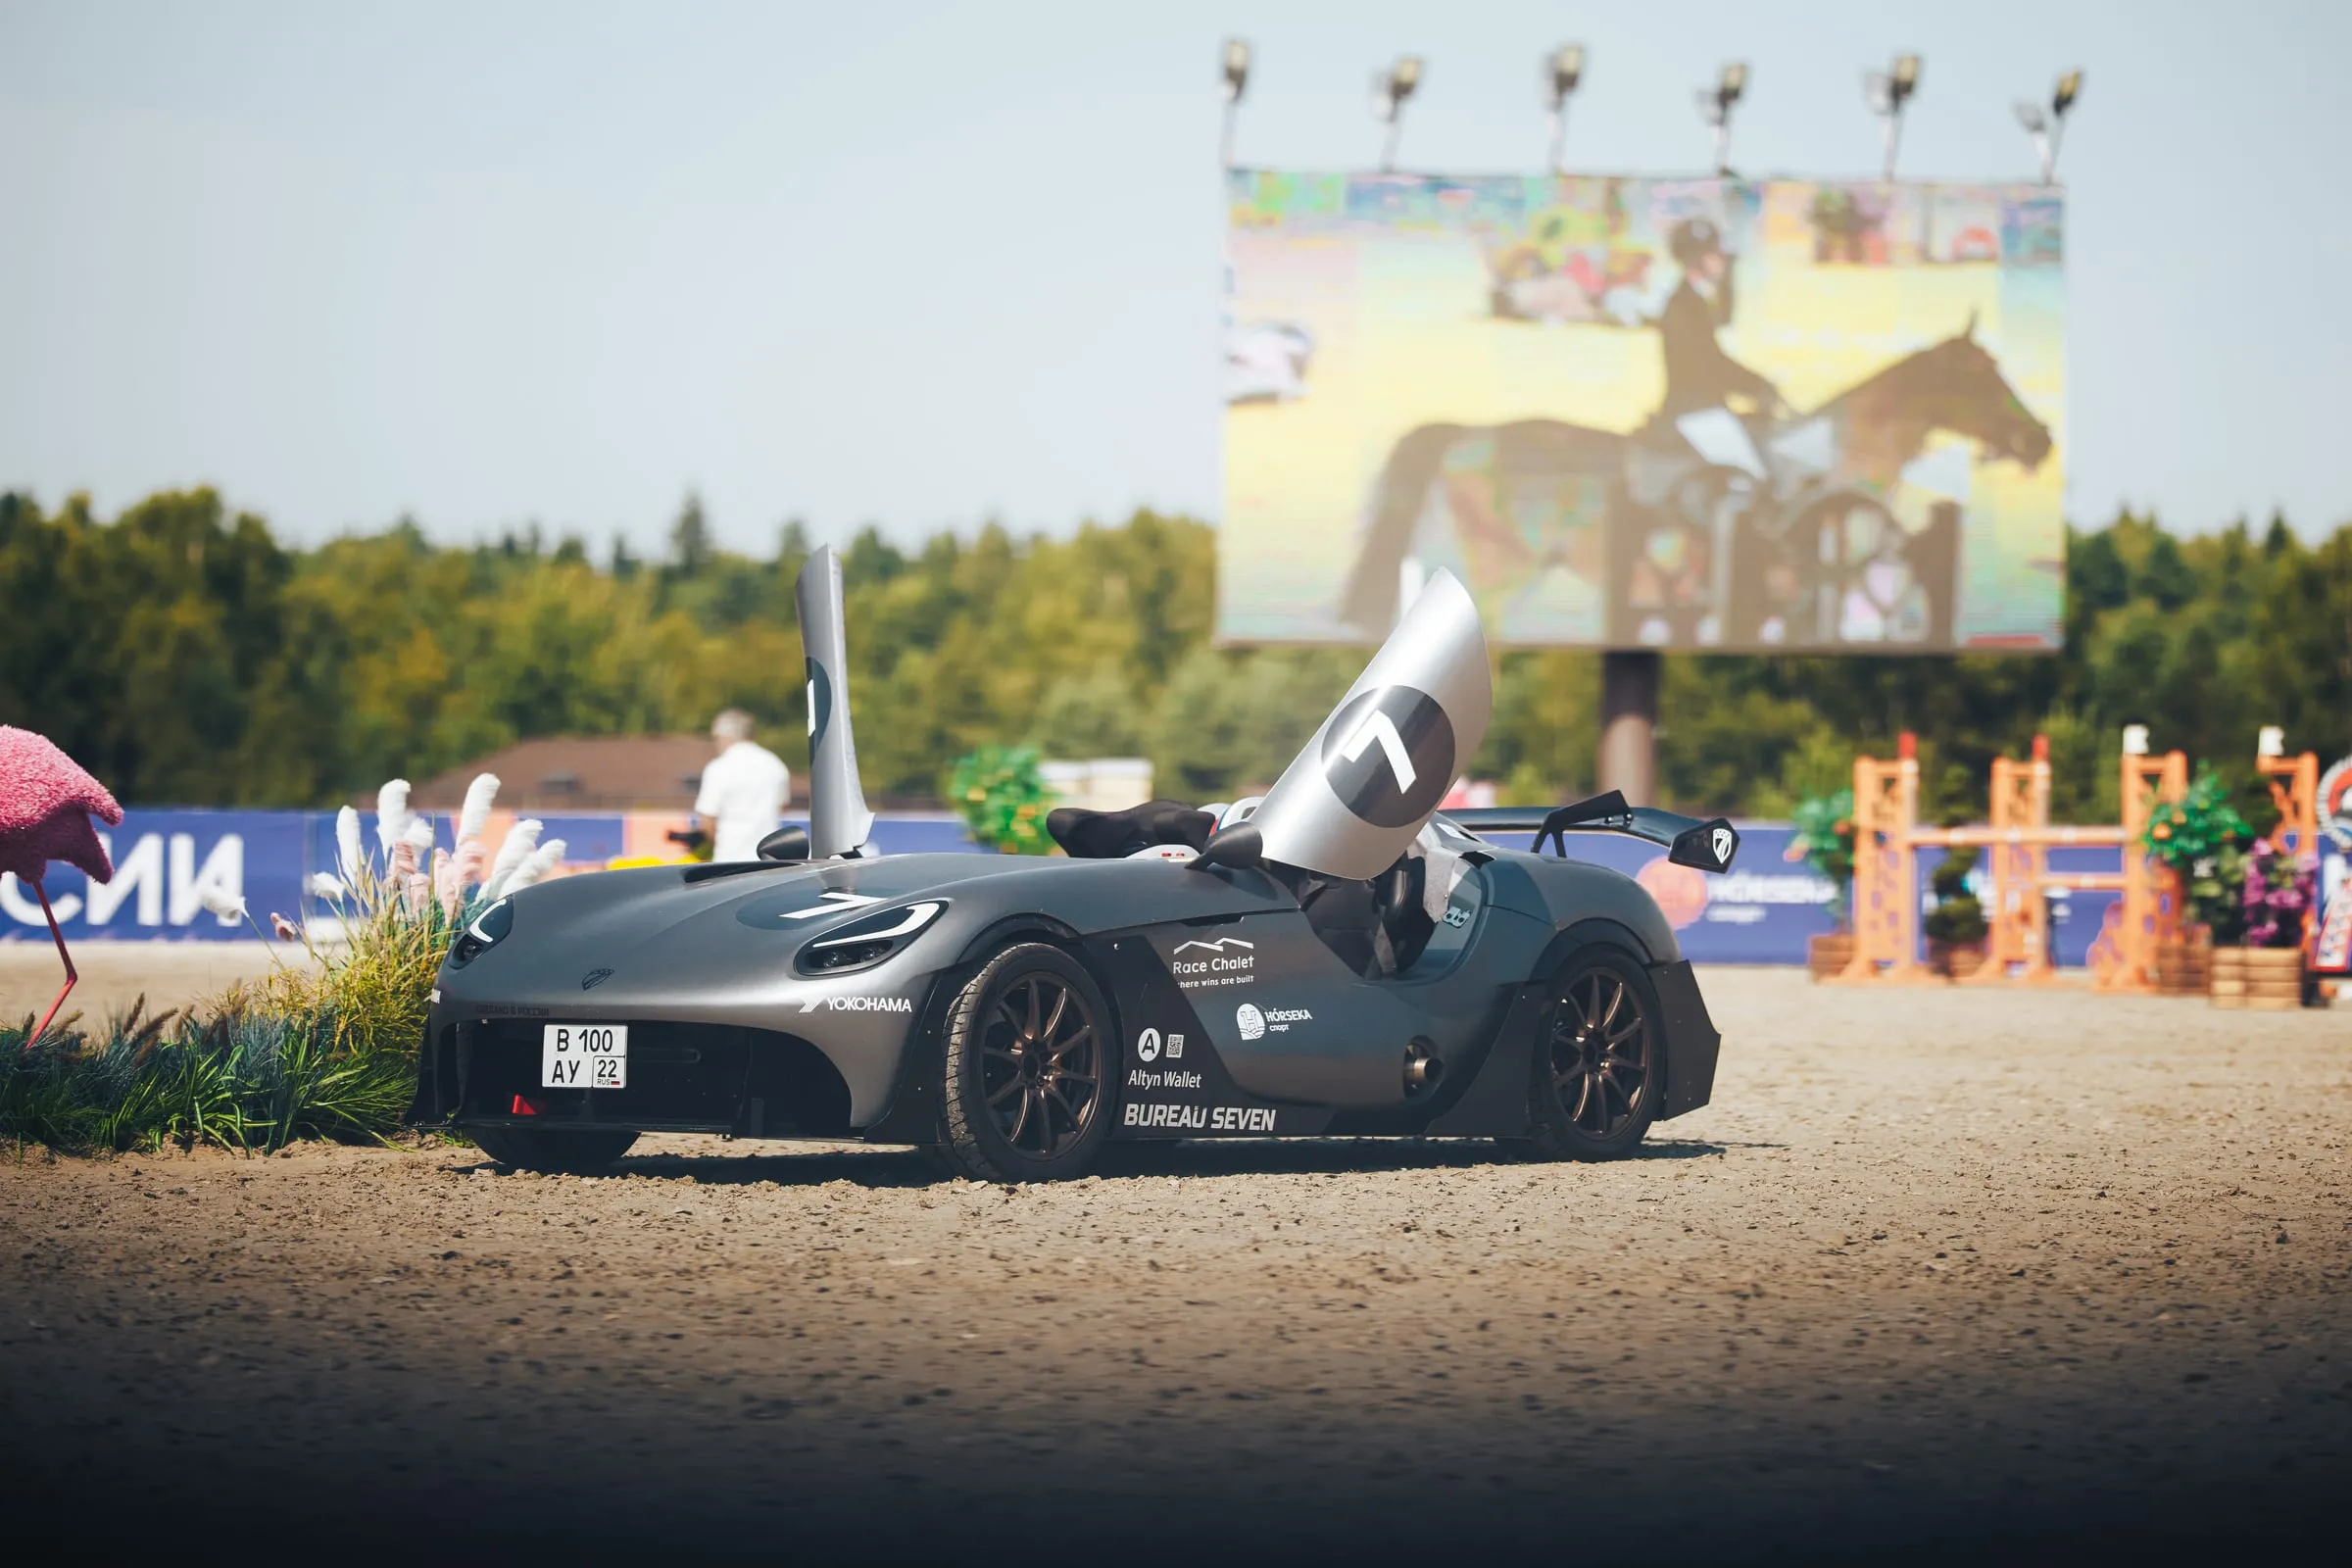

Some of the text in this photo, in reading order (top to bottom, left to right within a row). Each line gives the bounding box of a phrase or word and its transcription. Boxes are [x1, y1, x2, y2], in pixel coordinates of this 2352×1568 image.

[1172, 956, 1254, 975] Race Chalet
[1201, 978, 1219, 987] wins
[1236, 974, 1254, 984] built
[826, 997, 912, 1012] YOKOHAMA
[578, 1029, 613, 1053] 100
[1141, 1032, 1156, 1054] A
[597, 1059, 617, 1078] 22
[1128, 1069, 1201, 1090] Altyn Wallet
[1124, 1102, 1277, 1131] BUREAU SEVEN
